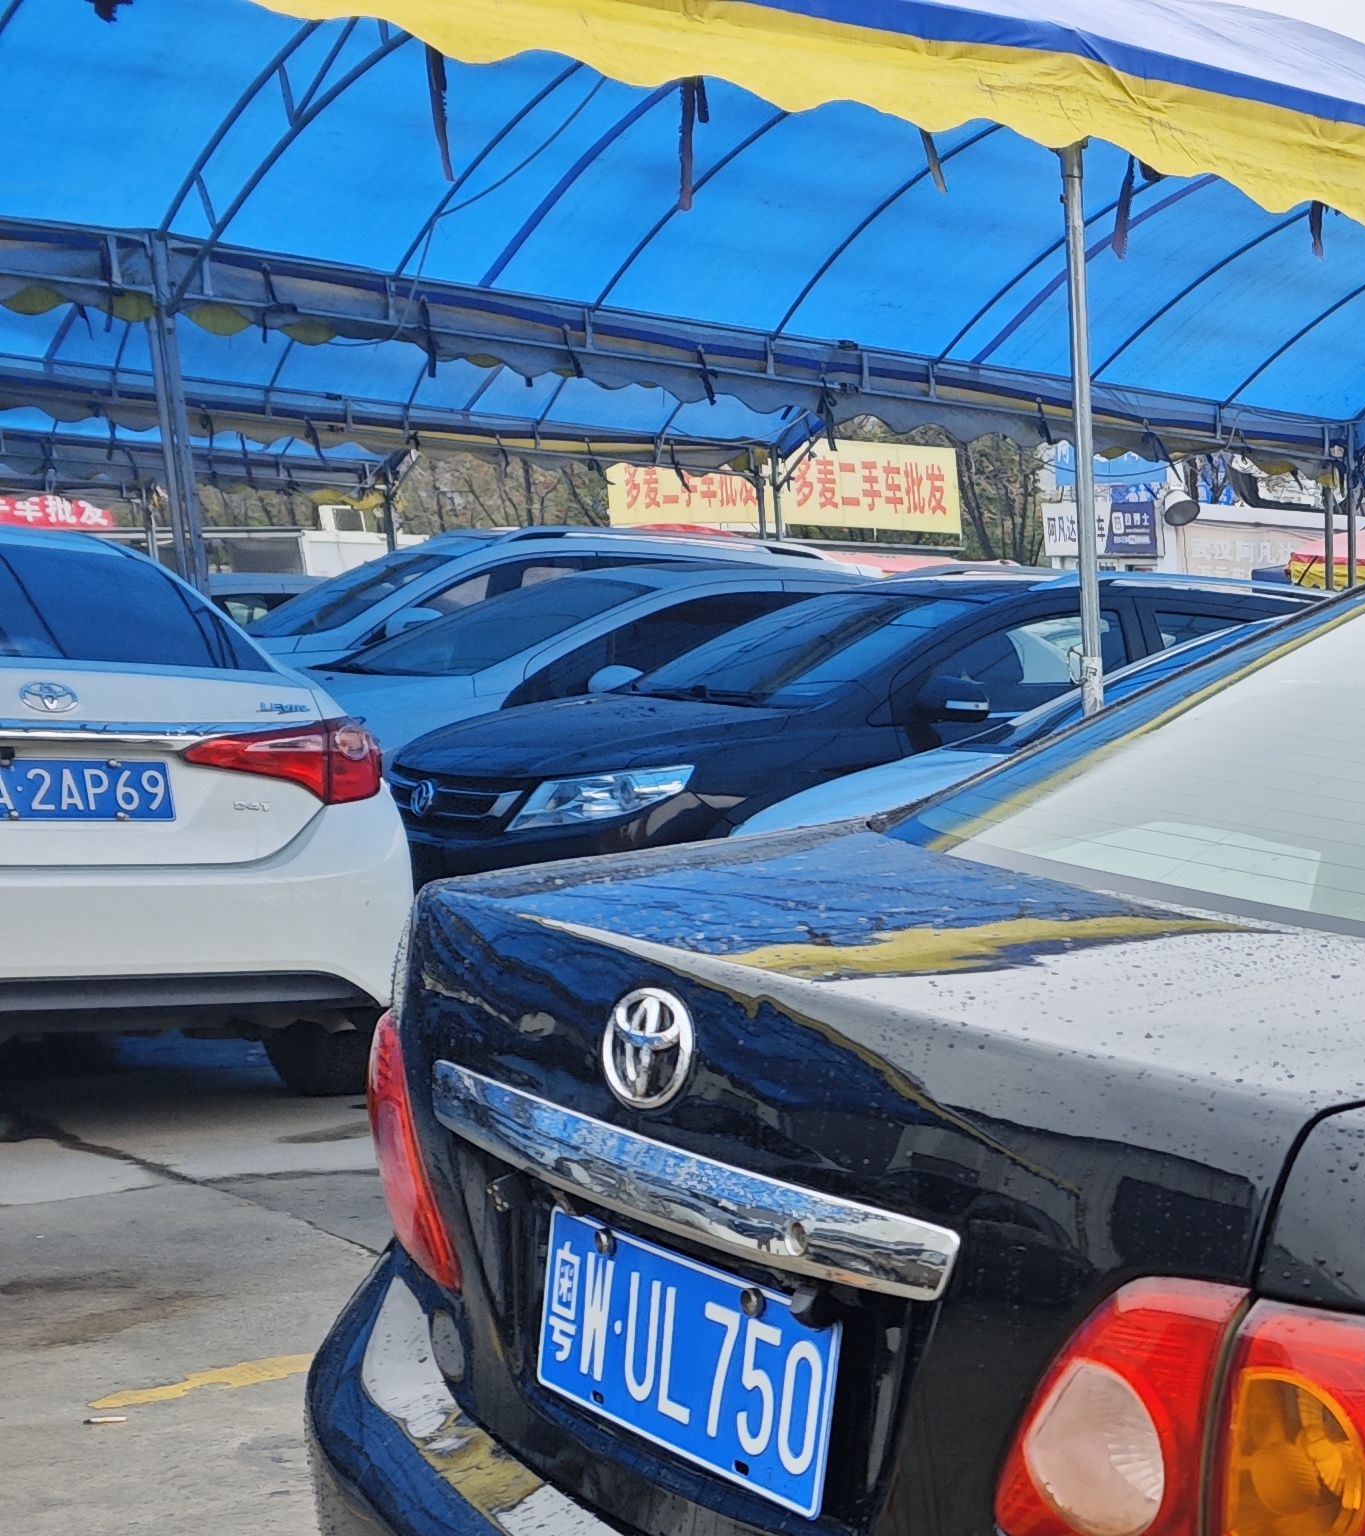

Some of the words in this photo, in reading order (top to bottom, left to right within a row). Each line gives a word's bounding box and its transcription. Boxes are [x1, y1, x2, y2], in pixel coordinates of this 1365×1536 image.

[794, 455, 946, 515] 多麦二手车批发
[1047, 515, 1106, 543] 阿凡达车
